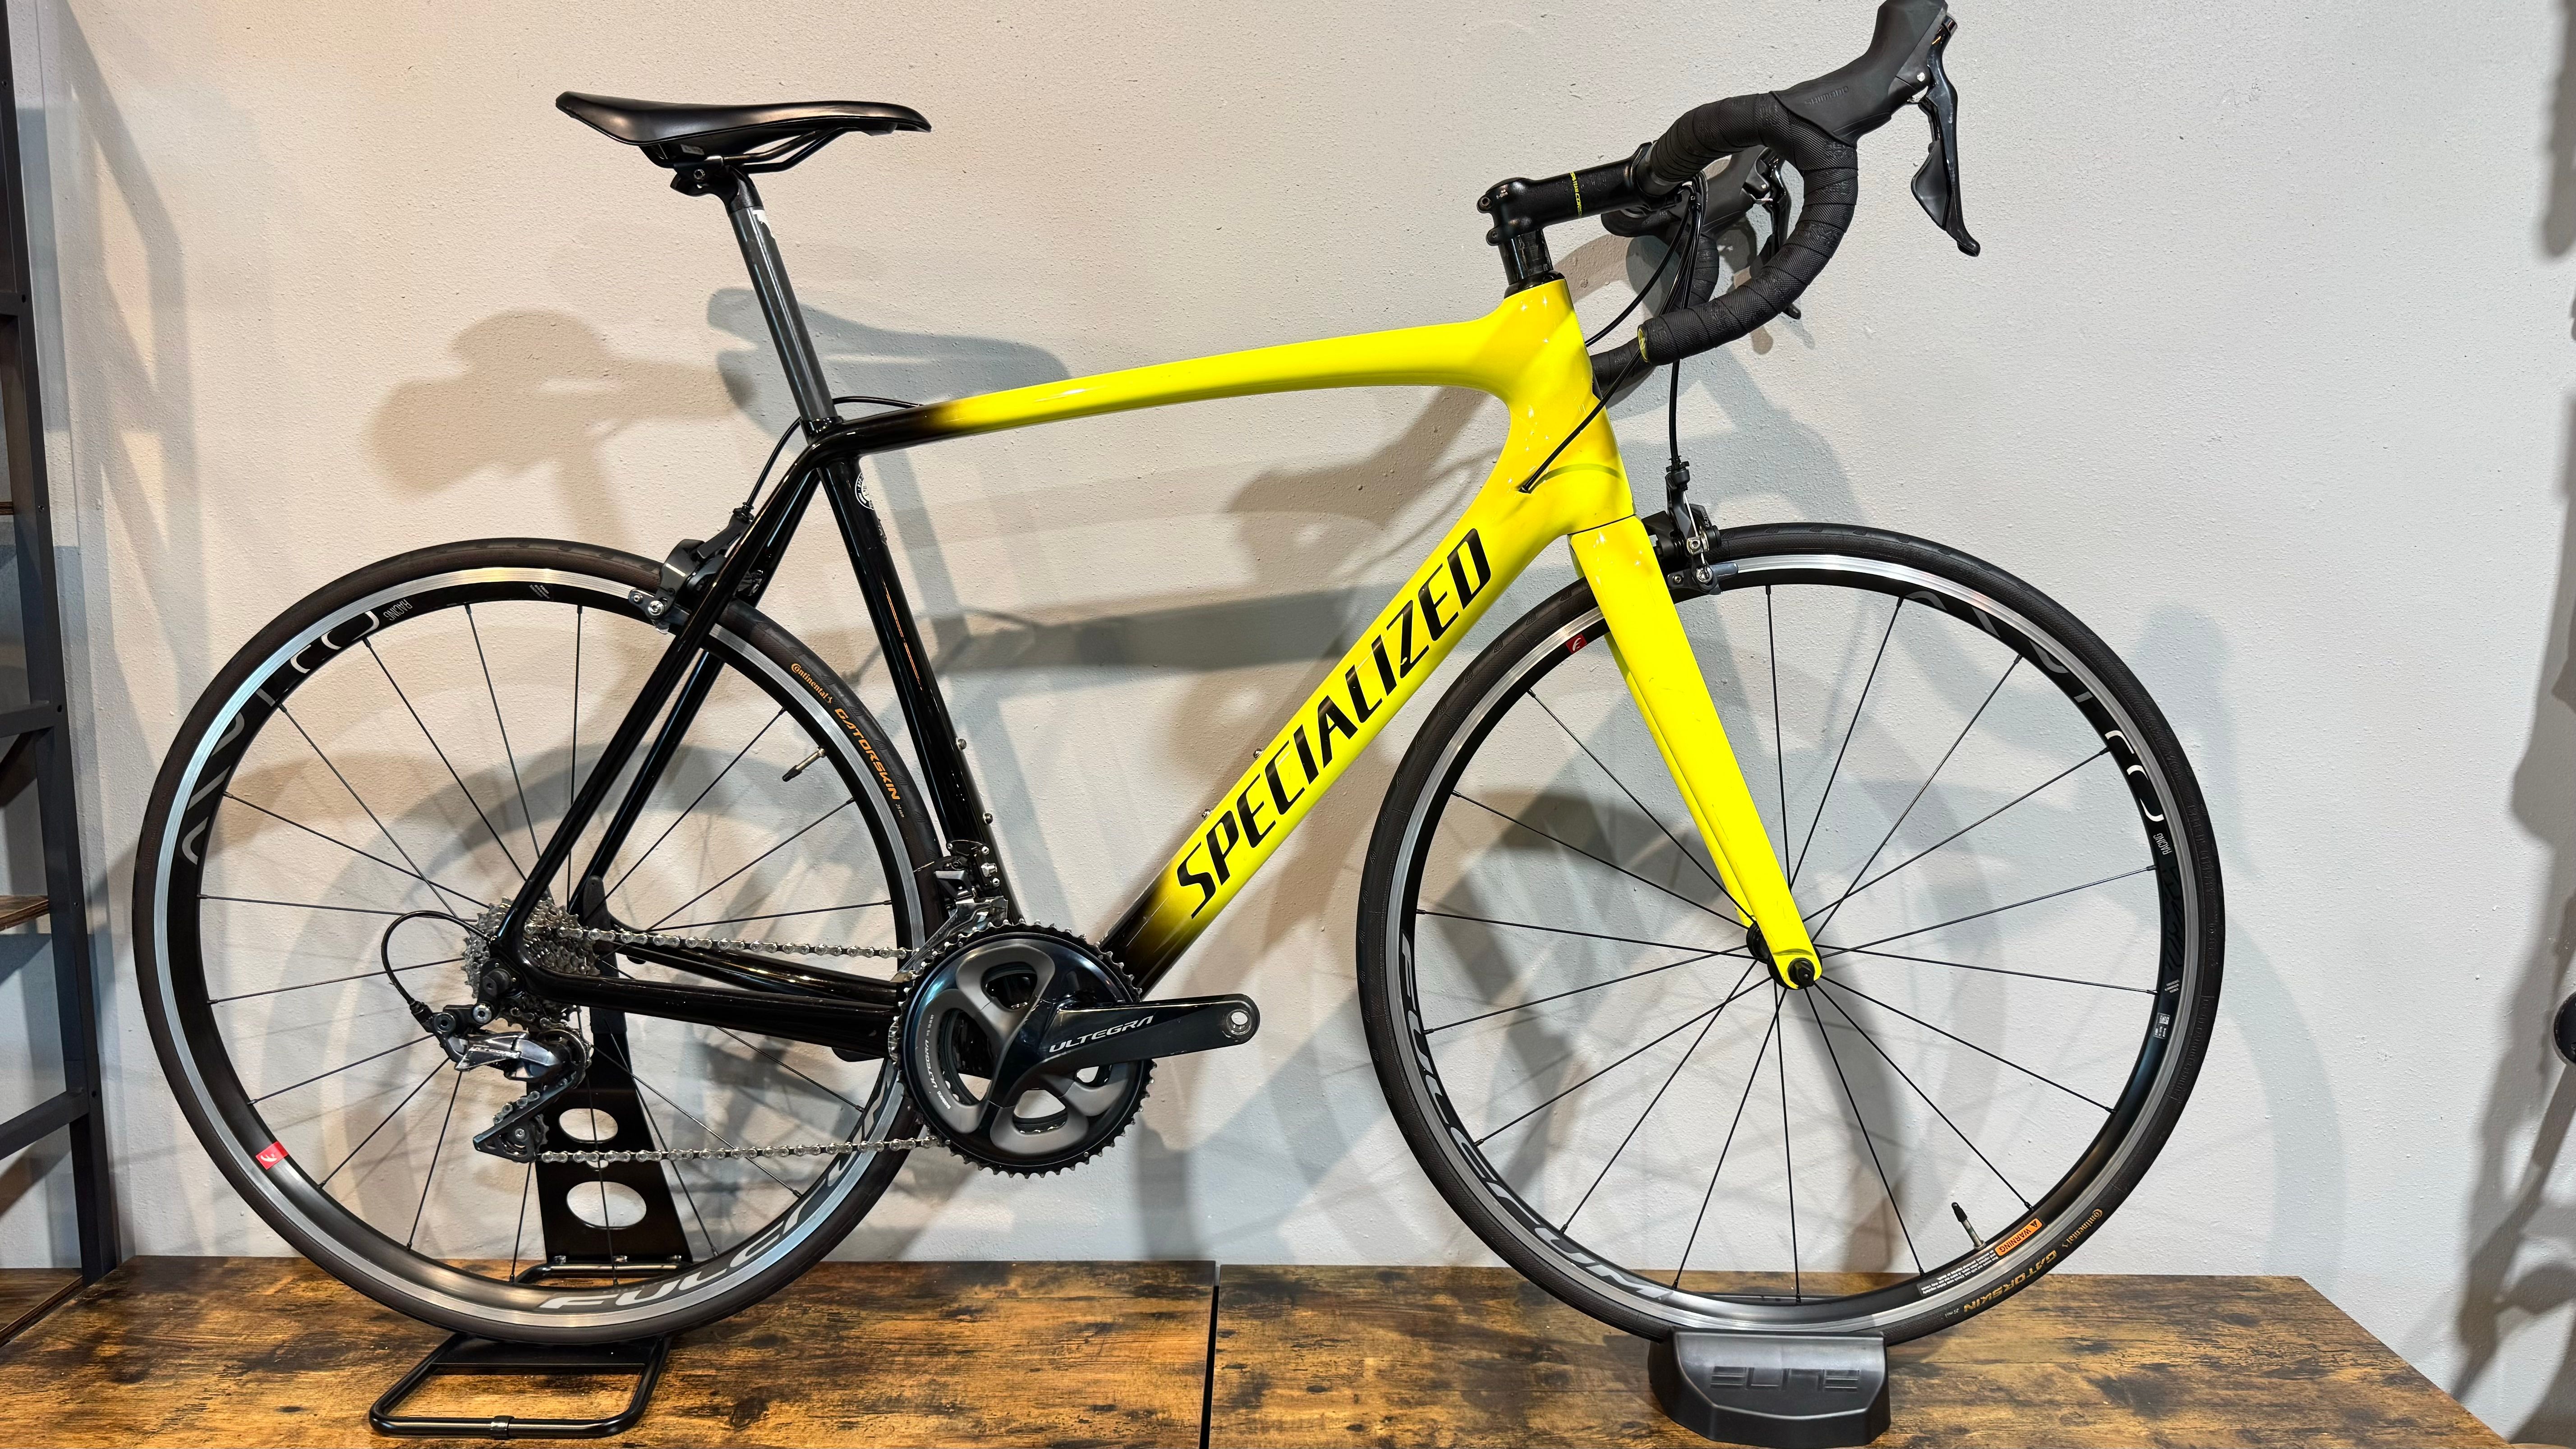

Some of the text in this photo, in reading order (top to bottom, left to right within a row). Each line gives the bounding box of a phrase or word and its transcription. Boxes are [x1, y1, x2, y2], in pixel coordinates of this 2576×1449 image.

[1803, 85, 1849, 106] SHIMANO
[383, 599, 413, 621] RACING
[791, 663, 828, 700] Continental
[835, 708, 900, 800] GATORSKIN
[1177, 529, 1491, 919] SPECIALIZED
[2153, 833, 2173, 856] RACING
[1049, 1015, 1154, 1053] ULTEGRA
[925, 1039, 938, 1088] ULTEGRA
[1399, 928, 1674, 1300] FULCRUM
[1999, 1228, 2032, 1253] WARNING
[2067, 1209, 2103, 1246] Continental
[1964, 1250, 2057, 1313] GATORSKIN
[1710, 1366, 1859, 1392] ELITE
